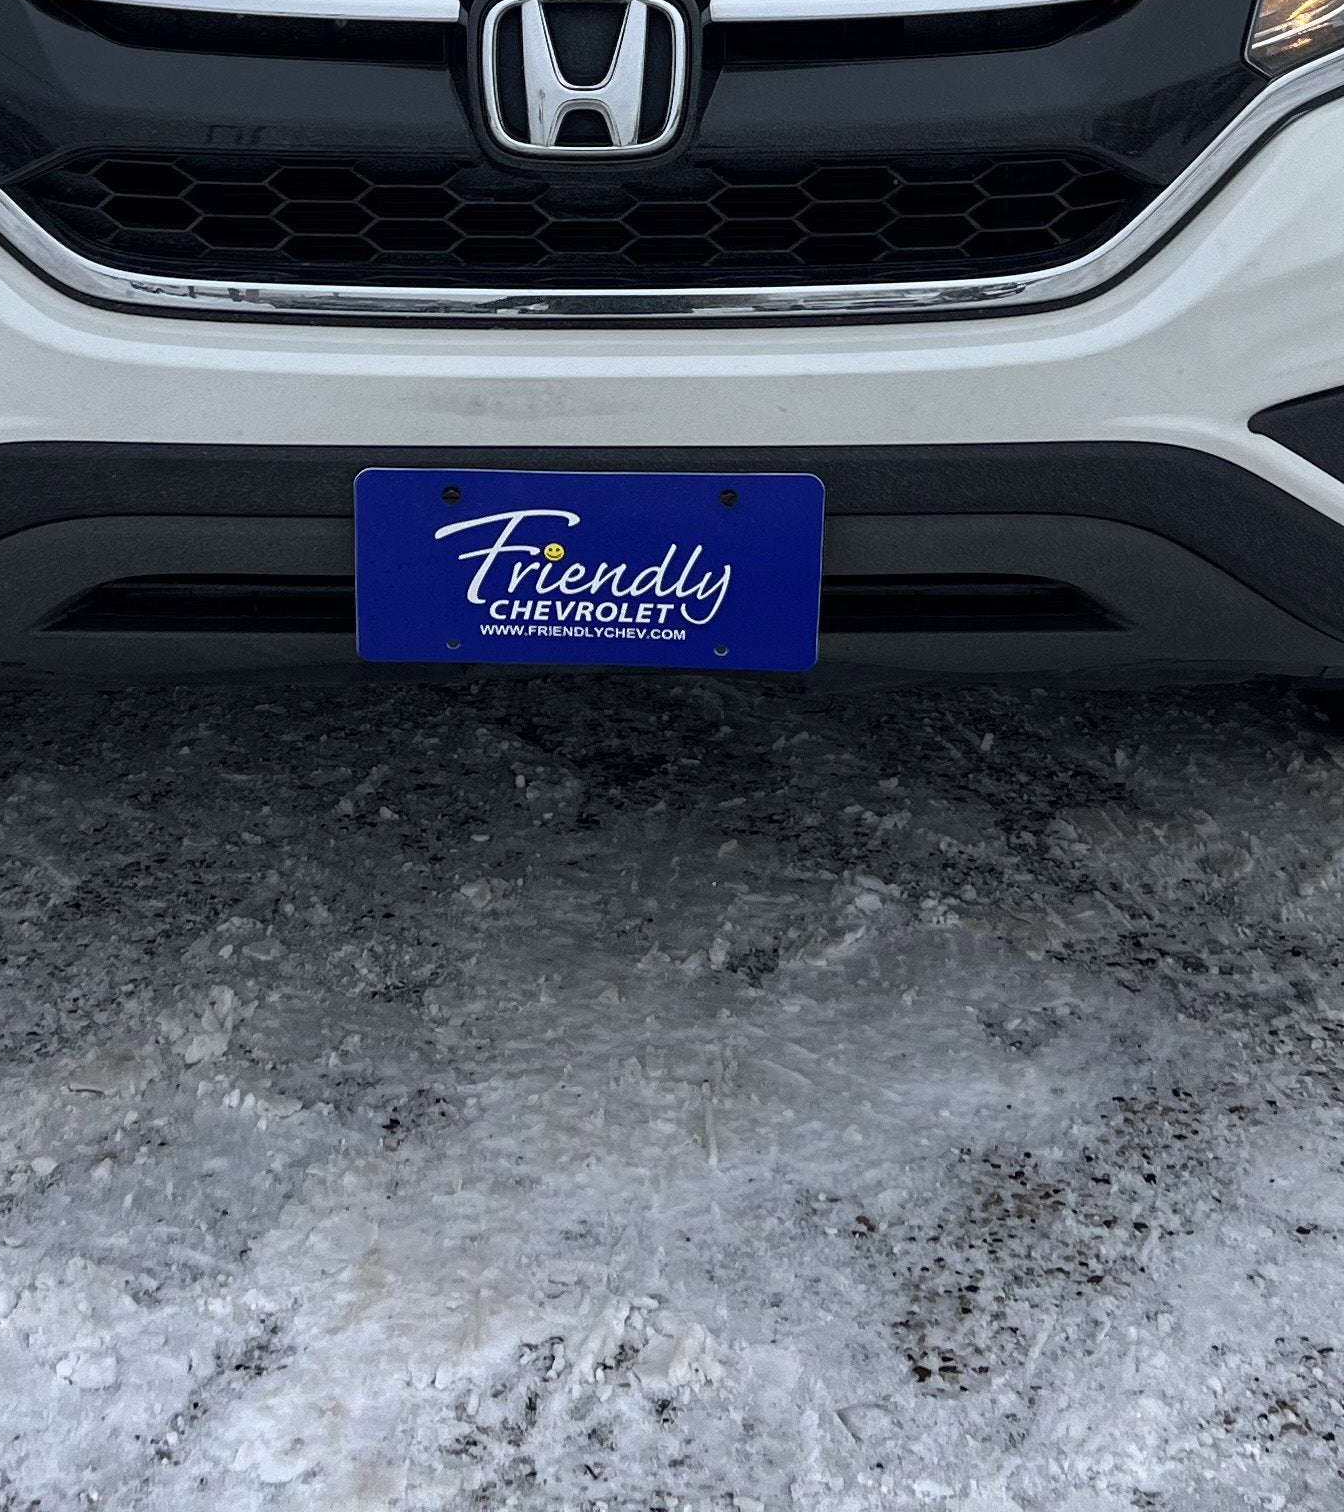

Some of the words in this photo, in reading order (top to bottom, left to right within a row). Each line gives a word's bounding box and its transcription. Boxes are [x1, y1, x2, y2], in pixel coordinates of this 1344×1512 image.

[434, 509, 731, 624] Friendly
[489, 599, 675, 625] CHEVROLET
[479, 624, 687, 641] WWW.FRIENDLYCHEV.COM
